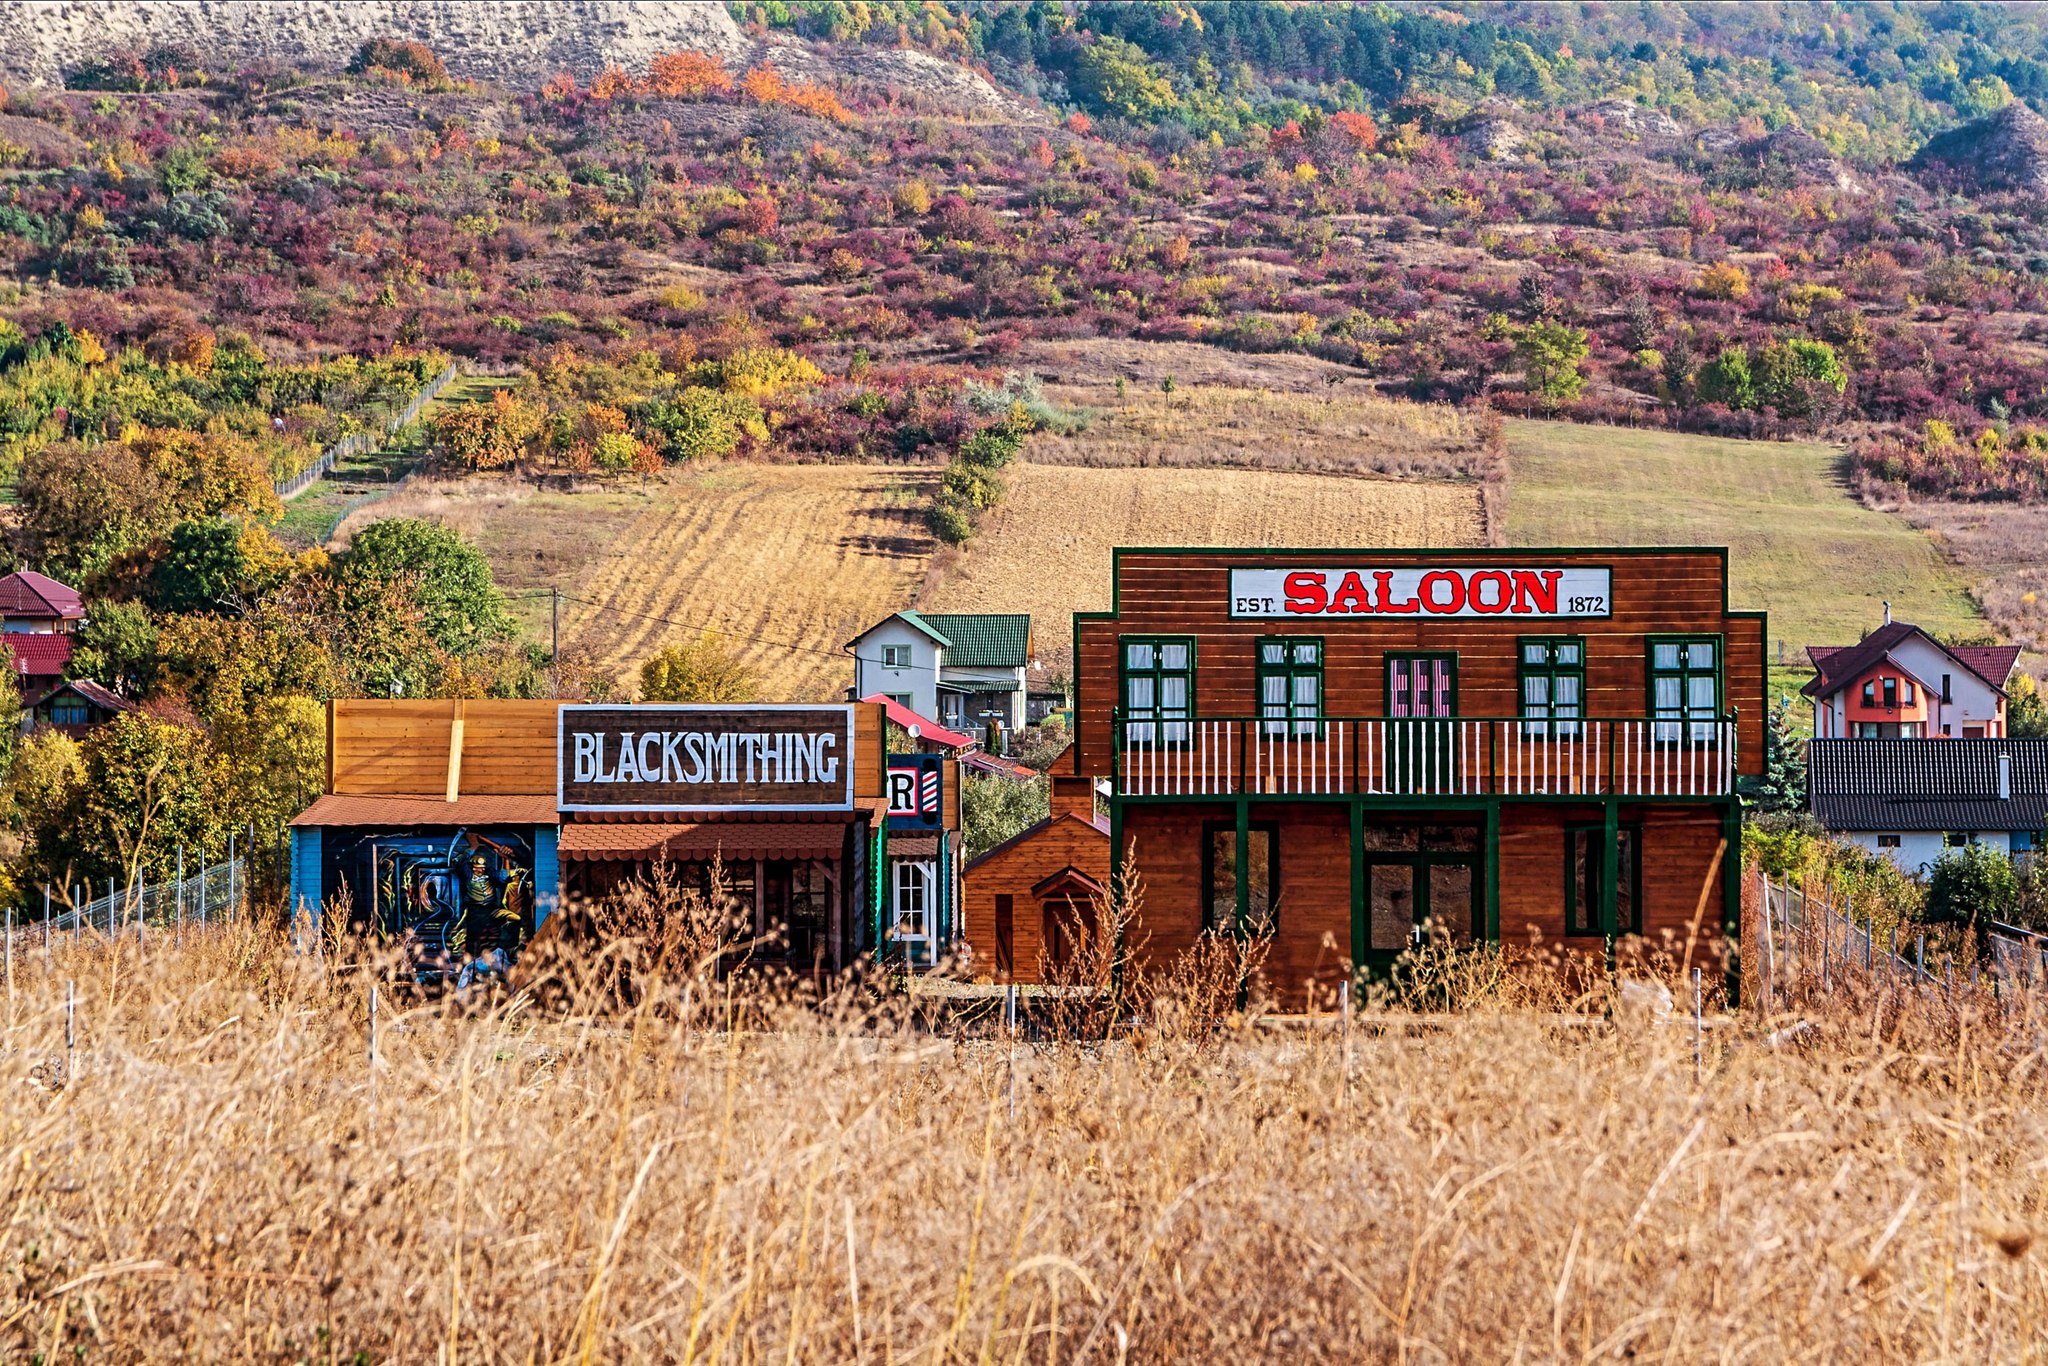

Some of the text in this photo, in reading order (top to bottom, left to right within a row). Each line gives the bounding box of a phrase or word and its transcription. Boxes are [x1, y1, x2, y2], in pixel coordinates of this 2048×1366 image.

[1236, 570, 1606, 615] EST. SALOON 1872
[572, 732, 839, 784] BLACKSMITHING
[887, 773, 914, 810] R
